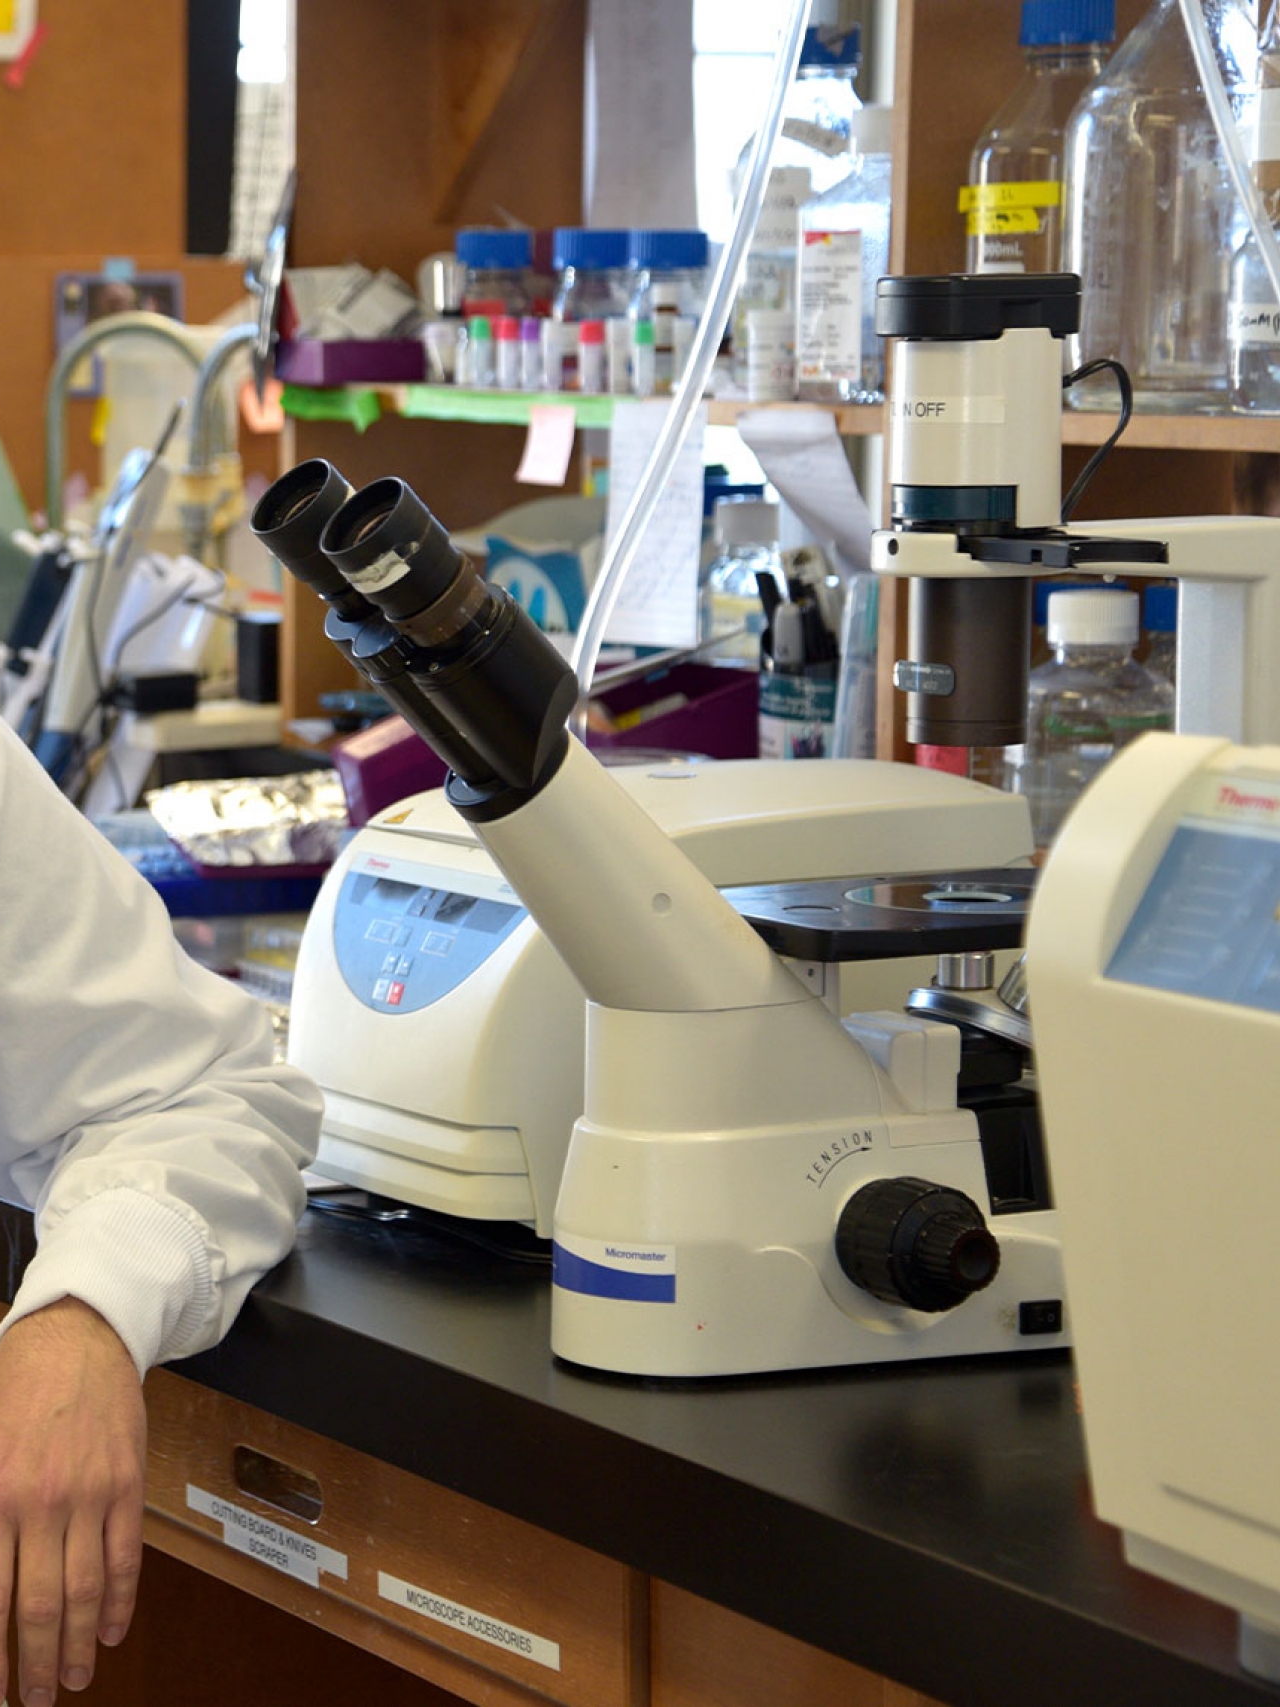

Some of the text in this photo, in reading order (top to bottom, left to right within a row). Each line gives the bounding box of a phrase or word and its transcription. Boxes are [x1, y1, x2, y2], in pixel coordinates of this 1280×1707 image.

[914, 402, 945, 417] OFF
[806, 1129, 872, 1183] TENSION
[605, 1247, 666, 1262] Micromaster
[211, 1501, 317, 1561] CUTTING BOARD & KNIVES
[248, 1538, 289, 1568] SCRAPER
[406, 1588, 532, 1654] MICROSCOPE ACCESSORIES
